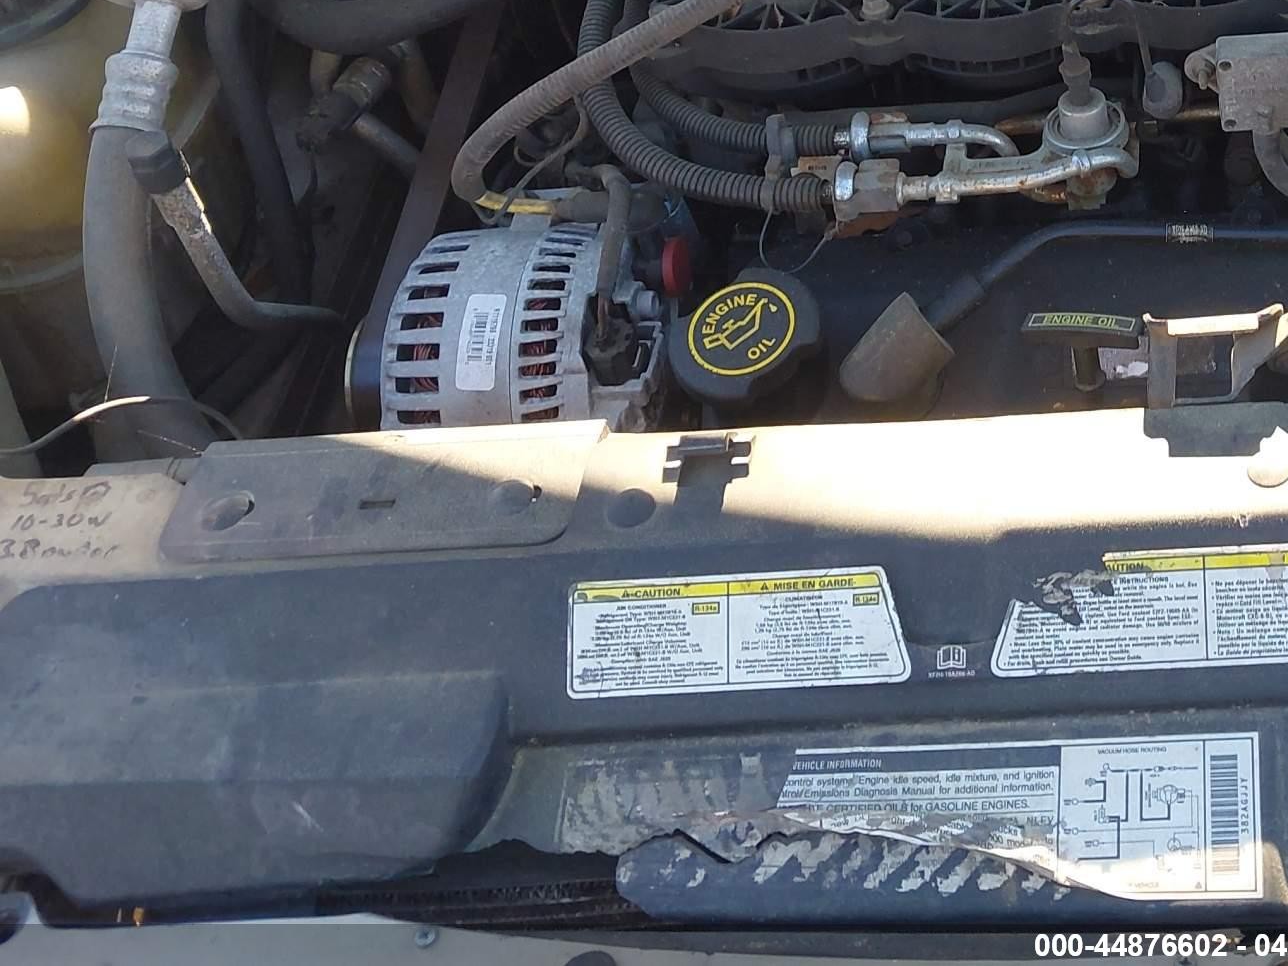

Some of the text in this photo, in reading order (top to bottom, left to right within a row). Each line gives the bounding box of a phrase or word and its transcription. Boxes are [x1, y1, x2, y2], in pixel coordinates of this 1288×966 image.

[702, 294, 757, 334] ENGINE
[1043, 315, 1119, 328] ENGINE OIL
[747, 338, 776, 360] OIL
[1107, 563, 1144, 571] AUTION
[774, 578, 854, 590] MISE EN GARDE
[636, 588, 681, 598] CAUTION
[792, 759, 882, 770] VEHICLE INFORMATION
[859, 776, 889, 784] Engine
[893, 776, 908, 784] idle
[912, 775, 942, 785] speed,
[945, 774, 961, 783] idle
[965, 773, 999, 782] mixture,
[1003, 771, 1019, 780] and
[1024, 771, 1054, 783] ignition
[854, 787, 898, 798] Diagnosis
[902, 786, 935, 795] Manual
[939, 785, 951, 794] for
[955, 784, 998, 794] additional
[1001, 783, 1054, 792] information.
[910, 802, 922, 811] for
[925, 801, 979, 812] GASOLINE
[981, 799, 1030, 810] ENGINES.
